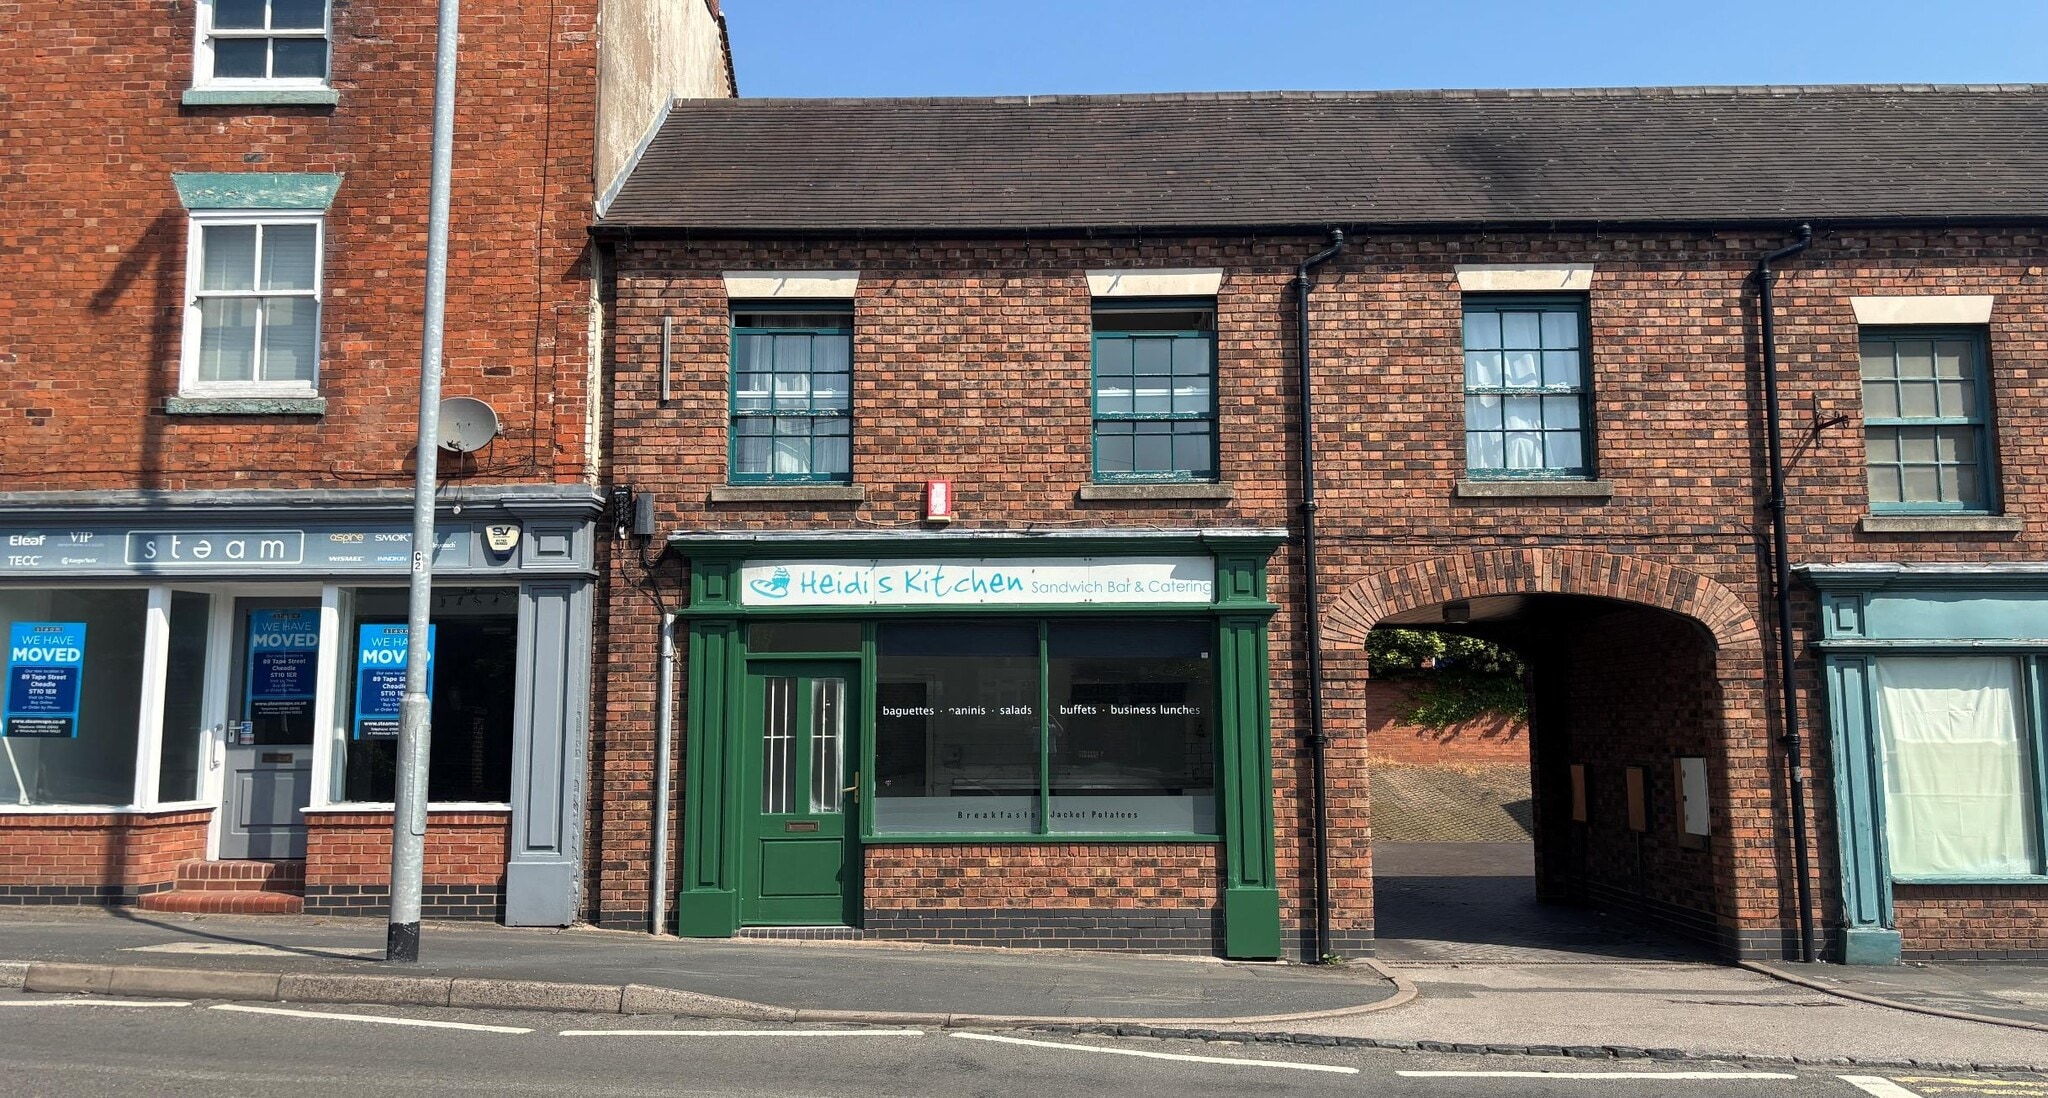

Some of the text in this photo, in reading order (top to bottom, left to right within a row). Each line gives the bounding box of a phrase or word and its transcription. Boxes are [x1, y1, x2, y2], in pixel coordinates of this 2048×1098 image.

[492, 527, 511, 536] SV
[10, 535, 46, 546] Eleaf
[70, 532, 93, 542] VIP
[330, 533, 364, 543] aspire
[8, 556, 39, 566] TECC
[415, 552, 421, 560] C
[800, 564, 1212, 597] Heidi's Kitchen Sandwich Bar & Catering
[262, 622, 312, 631] WE HAVE
[22, 635, 74, 645] WE HAVE
[253, 634, 318, 647] MOVED
[372, 638, 409, 646] WE HA
[12, 647, 80, 662] MOVED
[882, 706, 934, 718] baguettes
[1000, 705, 1032, 714] salads
[1060, 705, 1200, 714] buffets business lunches
[958, 810, 1138, 819] Breakfasts Jacket Potatoes
